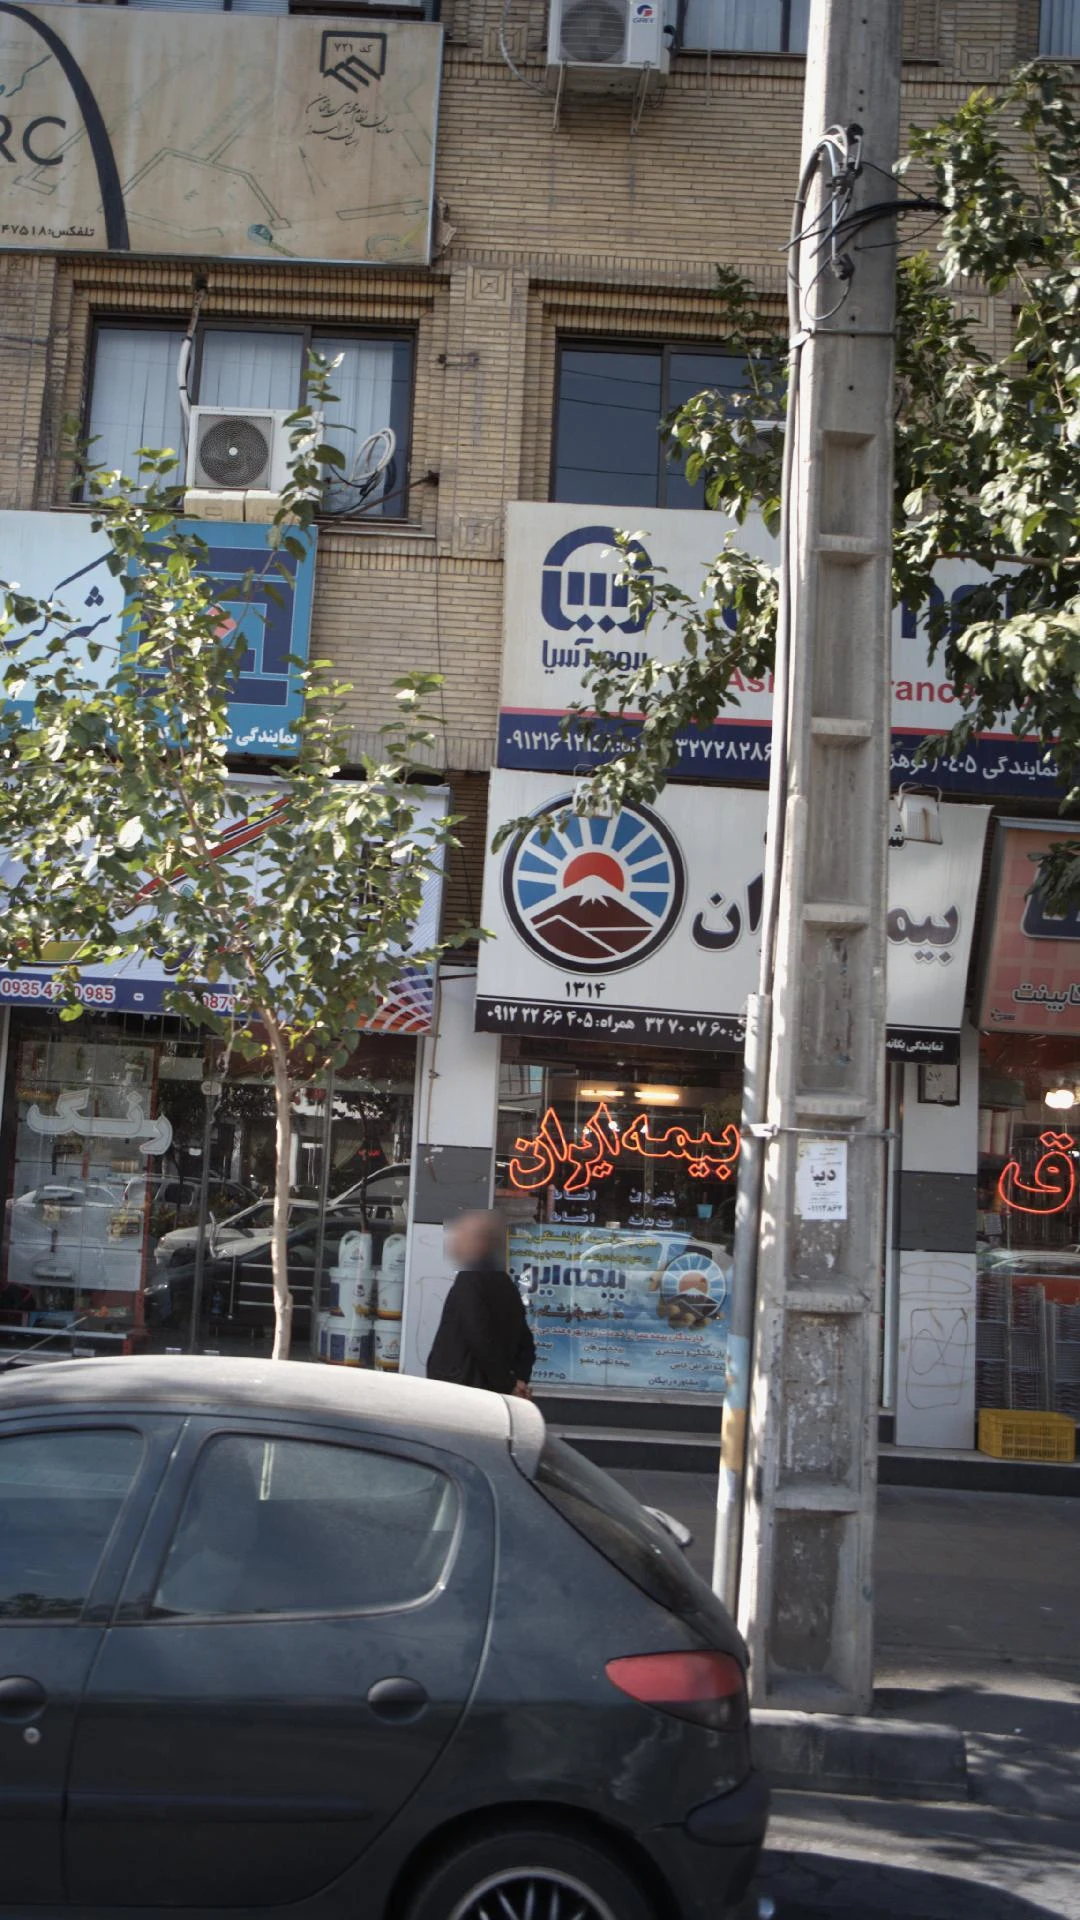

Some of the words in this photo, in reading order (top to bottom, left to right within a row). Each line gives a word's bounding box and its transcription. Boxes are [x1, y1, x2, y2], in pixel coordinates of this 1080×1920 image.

[982, 756, 1060, 781] نمایندگی
[1, 979, 40, 998] 0935
[84, 986, 116, 1002] 985
[565, 980, 607, 999] ۱۳۱۴
[567, 1011, 593, 1028] ۴۰۵
[509, 1101, 621, 1191] ایران
[621, 1113, 742, 1181] بیمه
[563, 1267, 626, 1300] بیمه
